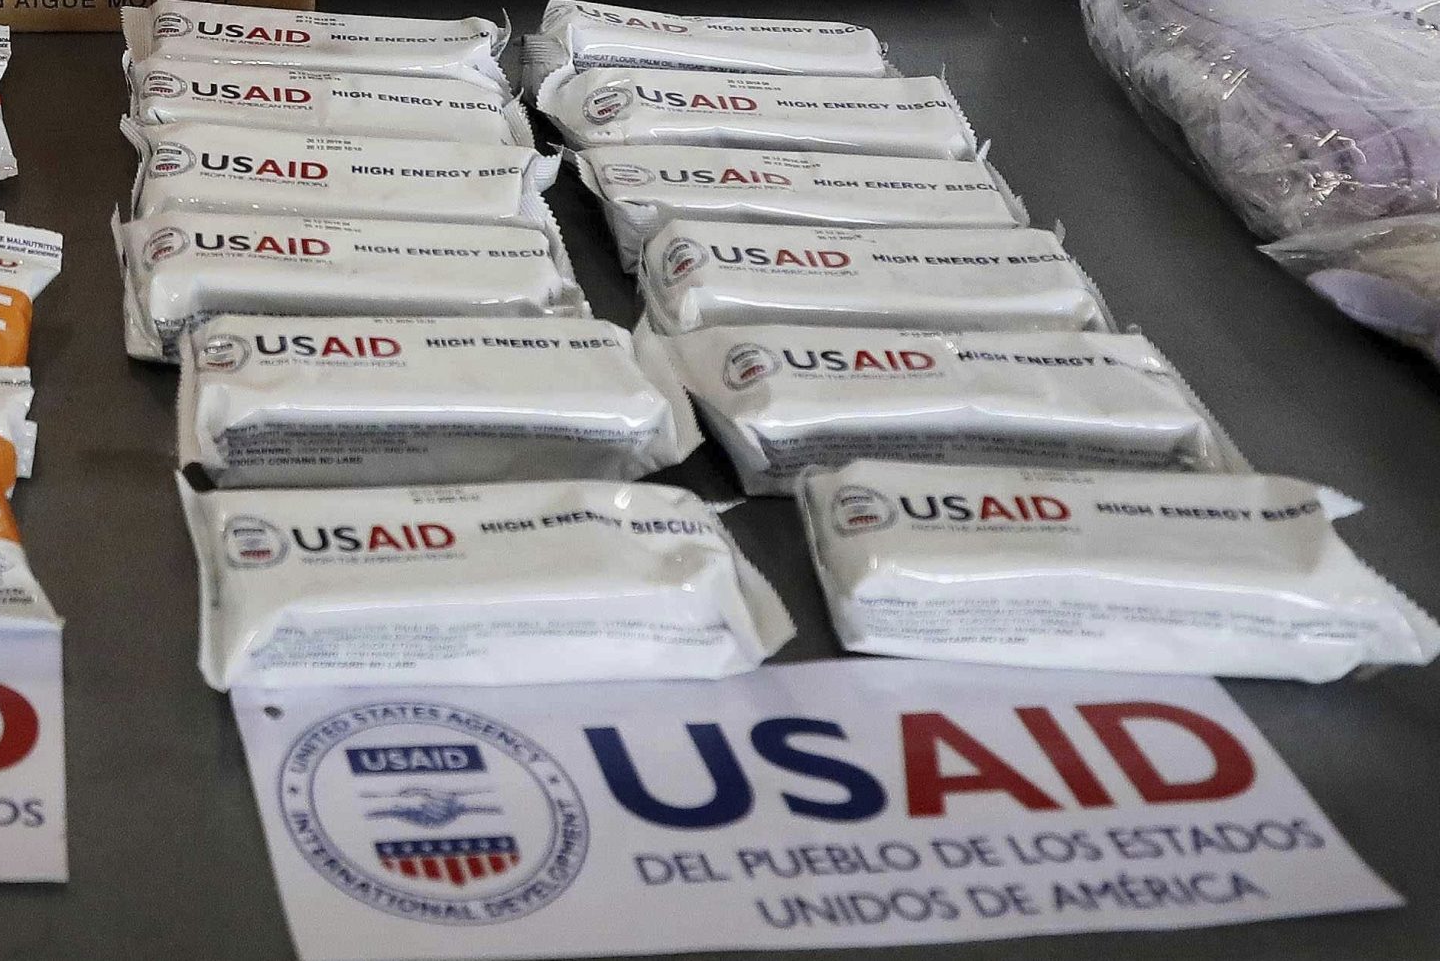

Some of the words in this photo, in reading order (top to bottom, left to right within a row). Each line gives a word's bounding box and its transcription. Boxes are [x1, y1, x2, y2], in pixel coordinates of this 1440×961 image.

[573, 4, 691, 36] USAID
[198, 22, 310, 45] USAID
[192, 82, 311, 106] USAID
[636, 85, 763, 114] USAID
[202, 153, 328, 182] USAID
[660, 169, 791, 189] USAID
[196, 233, 329, 258] USAID
[711, 246, 850, 272] USAID
[255, 336, 401, 357] USAID
[783, 350, 935, 371] USAID
[900, 496, 1071, 522] USAID
[292, 524, 455, 553] USAID
[360, 746, 470, 772] USAID
[582, 701, 1256, 830] USAID
[633, 852, 730, 885] DEL
[736, 840, 922, 879] PUEBLO
[938, 838, 1006, 871] DE
[1015, 830, 1101, 867] LOS
[1111, 818, 1326, 859] ESTADOS
[754, 887, 961, 930] UNIDOS
[965, 883, 1041, 919] DE
[1051, 872, 1270, 913] AMÉRICA
